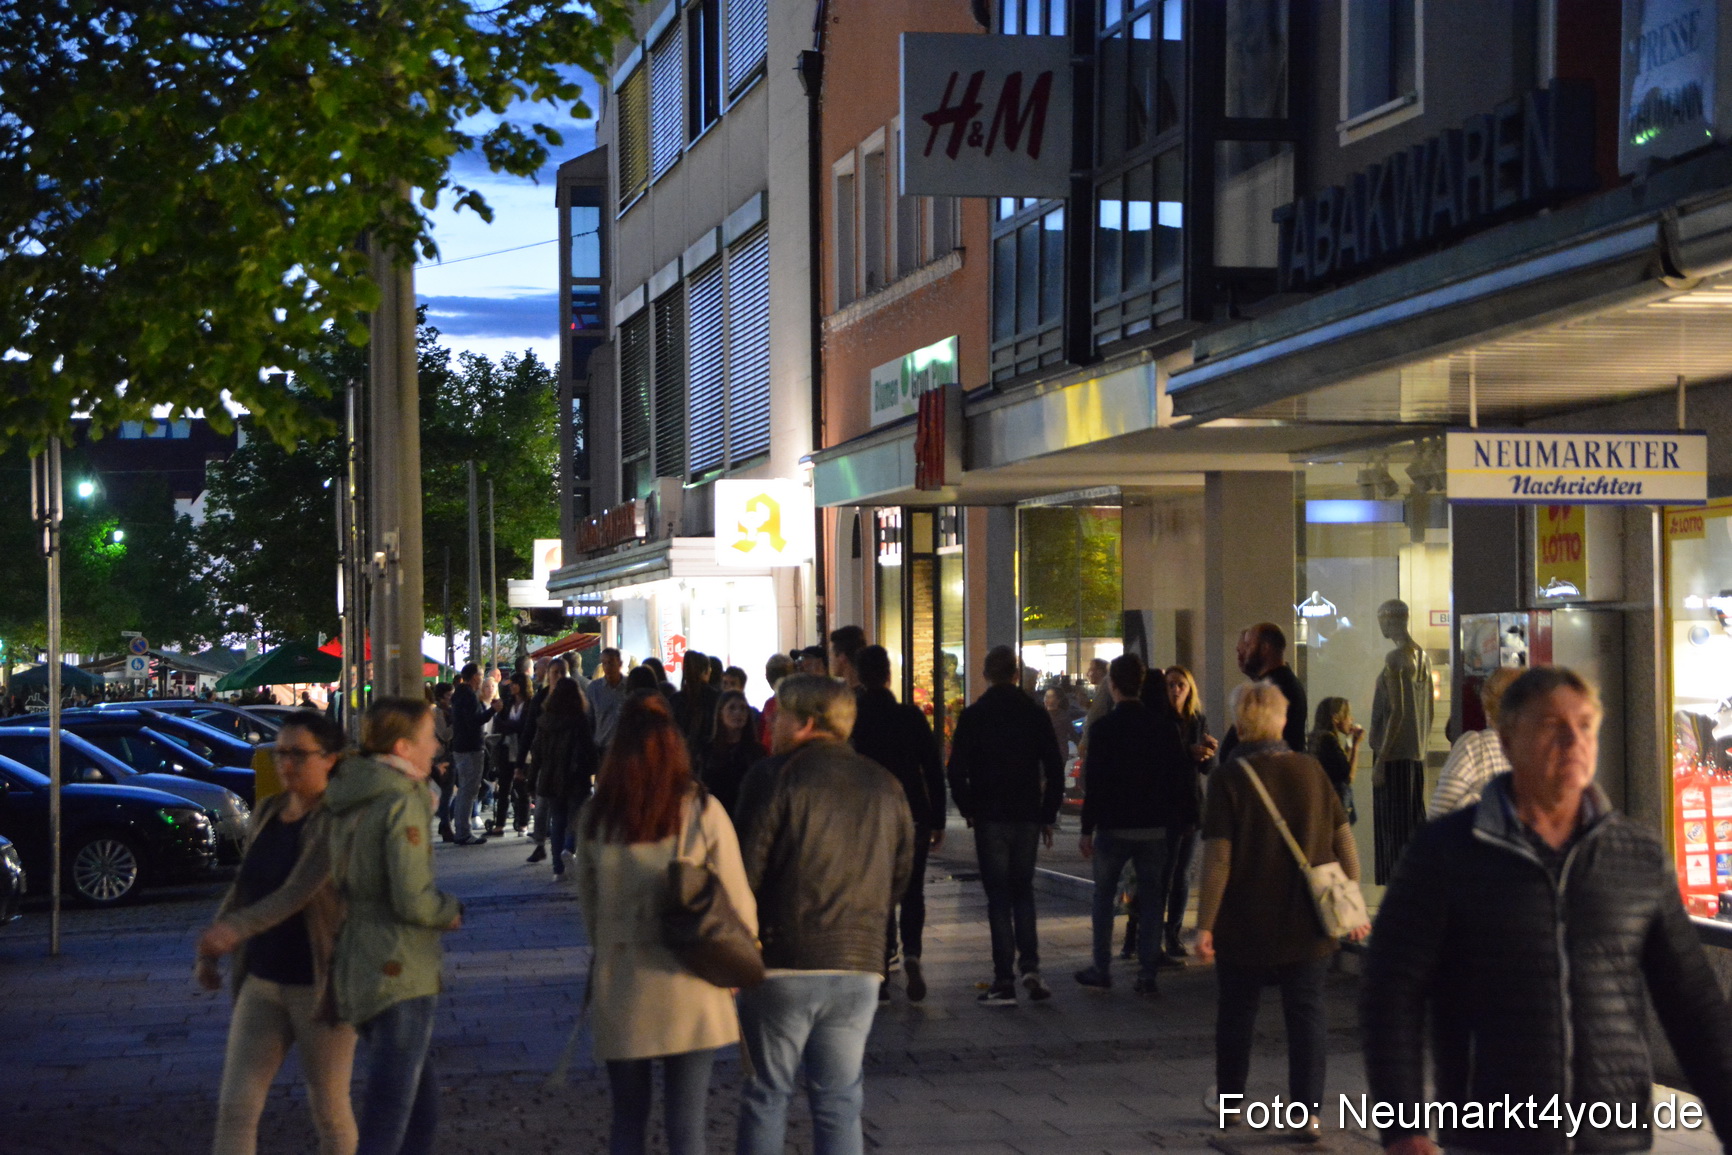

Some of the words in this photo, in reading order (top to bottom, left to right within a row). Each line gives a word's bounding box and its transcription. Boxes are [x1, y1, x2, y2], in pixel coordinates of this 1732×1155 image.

[922, 69, 1054, 161] H&M
[1272, 86, 1560, 292] TABAKWAREN
[1473, 440, 1681, 469] NEUMARKTER
[1508, 474, 1643, 496] Nachrichten
[1679, 515, 1704, 533] LOTTO
[1541, 532, 1582, 564] LOTTO
[566, 605, 609, 616] ESPRIT
